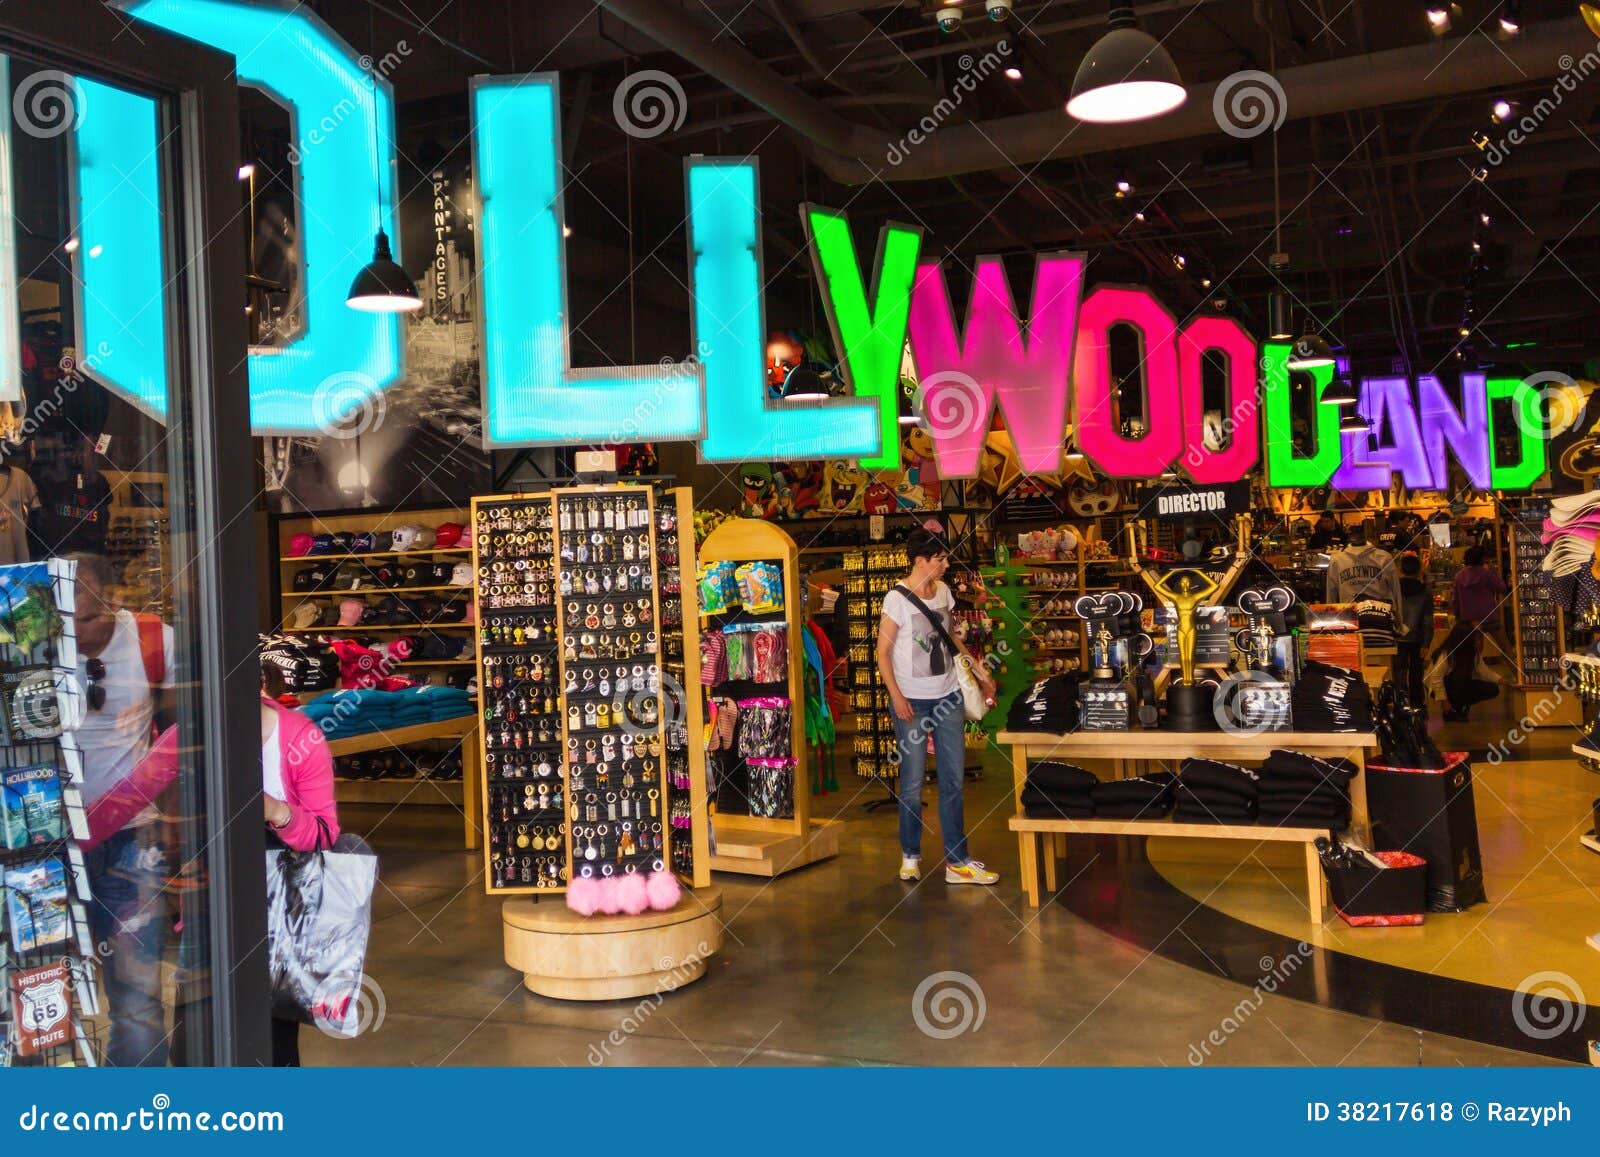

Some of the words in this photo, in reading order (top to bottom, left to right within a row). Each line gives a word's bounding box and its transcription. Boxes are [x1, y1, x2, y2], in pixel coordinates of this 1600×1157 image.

[433, 182, 447, 300] PANTAGES
[1158, 491, 1226, 515] DIRECTOR
[18, 967, 64, 987] HISTORIC
[32, 1003, 58, 1023] 66
[32, 1029, 65, 1048] ROUTE
